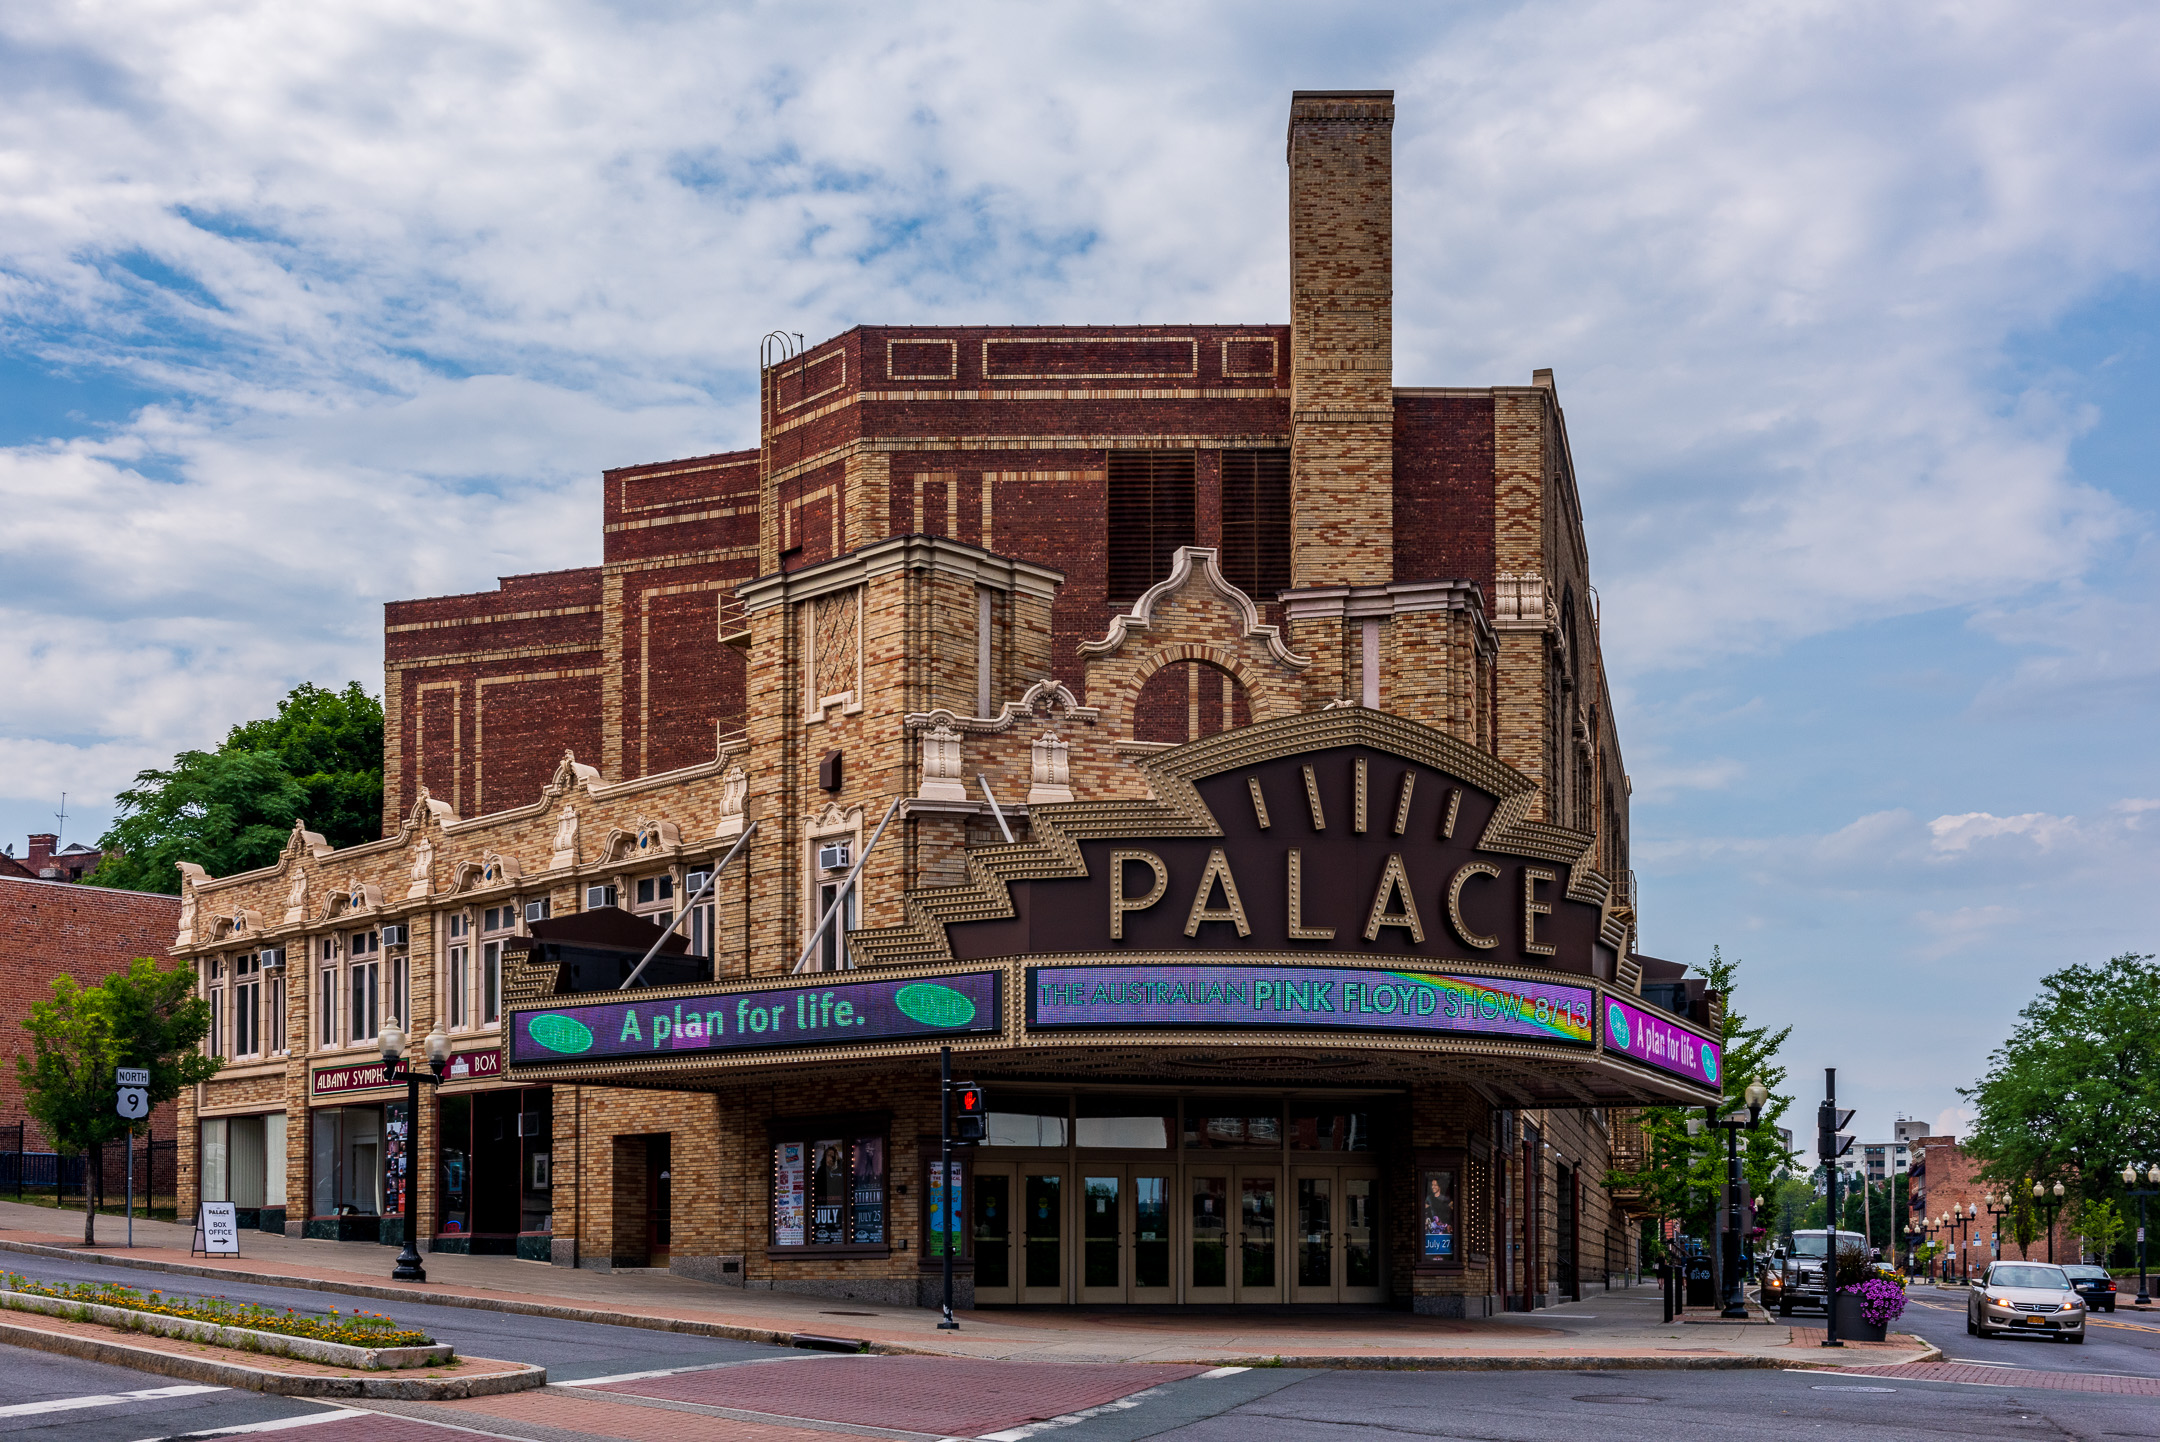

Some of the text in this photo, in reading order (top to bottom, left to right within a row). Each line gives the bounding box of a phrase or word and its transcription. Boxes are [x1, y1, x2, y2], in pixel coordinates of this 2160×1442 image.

[1109, 846, 1558, 956] PALACE
[1039, 982, 1085, 1006] THE
[1091, 980, 1247, 1006] AUSTRALIAN
[1252, 979, 1336, 1012] PINK
[1342, 982, 1437, 1016] FLOYD
[1443, 987, 1525, 1023] SHOW
[1533, 996, 1589, 1029] 8/13
[619, 1009, 643, 1043] A
[653, 1003, 724, 1049] plan
[736, 998, 786, 1034] for
[797, 991, 866, 1030] life.
[1636, 1016, 1645, 1049] A
[1646, 1021, 1665, 1059] plan
[1667, 1028, 1680, 1062] for
[1681, 1034, 1697, 1070] life.
[474, 1054, 497, 1072] BOX
[119, 1071, 147, 1082] NORTH
[316, 1065, 405, 1090] ALBANY SYMPHY
[127, 1093, 139, 1112] 9
[815, 1208, 839, 1224] JULY
[857, 1210, 882, 1224] JULY 25
[1425, 1239, 1451, 1250] July 27
